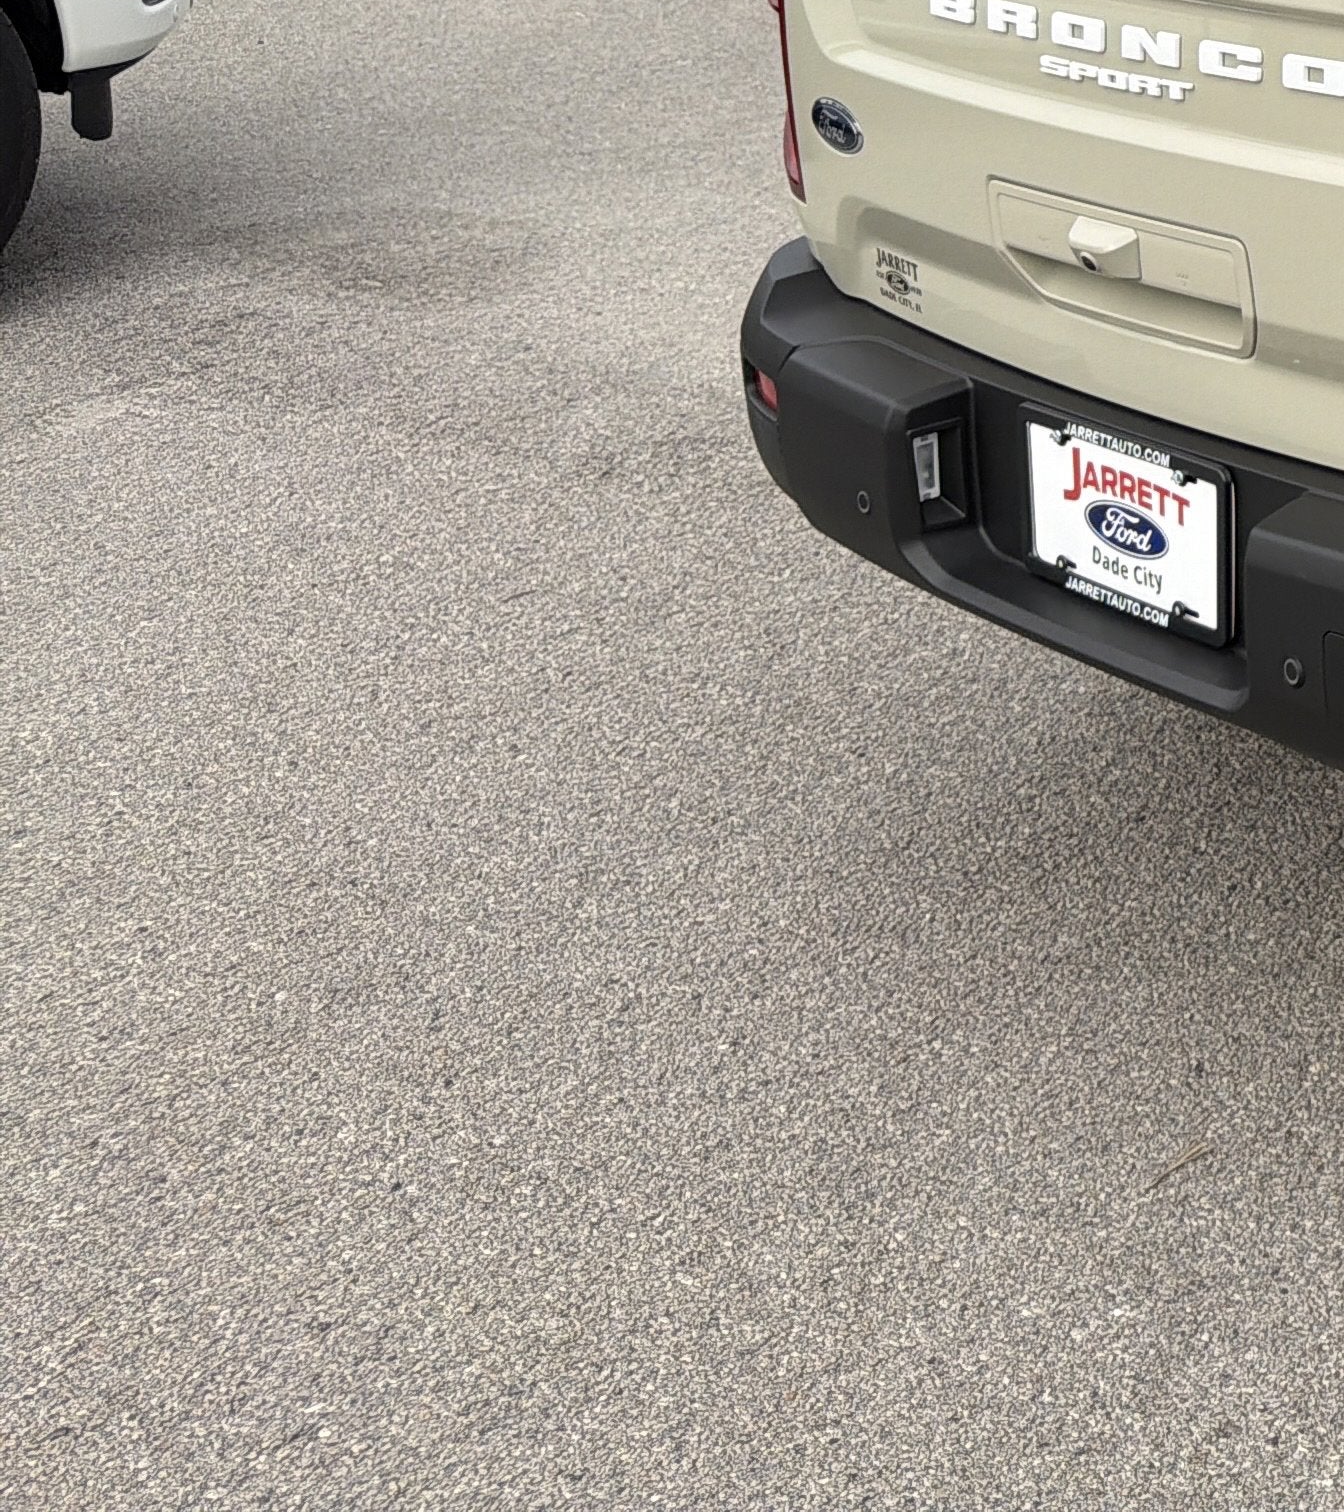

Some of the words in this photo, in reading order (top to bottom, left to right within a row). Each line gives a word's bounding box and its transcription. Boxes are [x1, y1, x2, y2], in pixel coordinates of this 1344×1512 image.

[1039, 54, 1195, 101] SPORT
[819, 109, 847, 144] Ford
[876, 247, 919, 283] JARRETT
[1063, 422, 1170, 468] JARRETTAUTO.COM
[1063, 447, 1191, 527] JARRETT
[1101, 507, 1152, 552] Ford
[1092, 545, 1129, 580] Dade
[1133, 565, 1163, 595] City
[1065, 576, 1170, 628] JARRETTAUTO.COM
